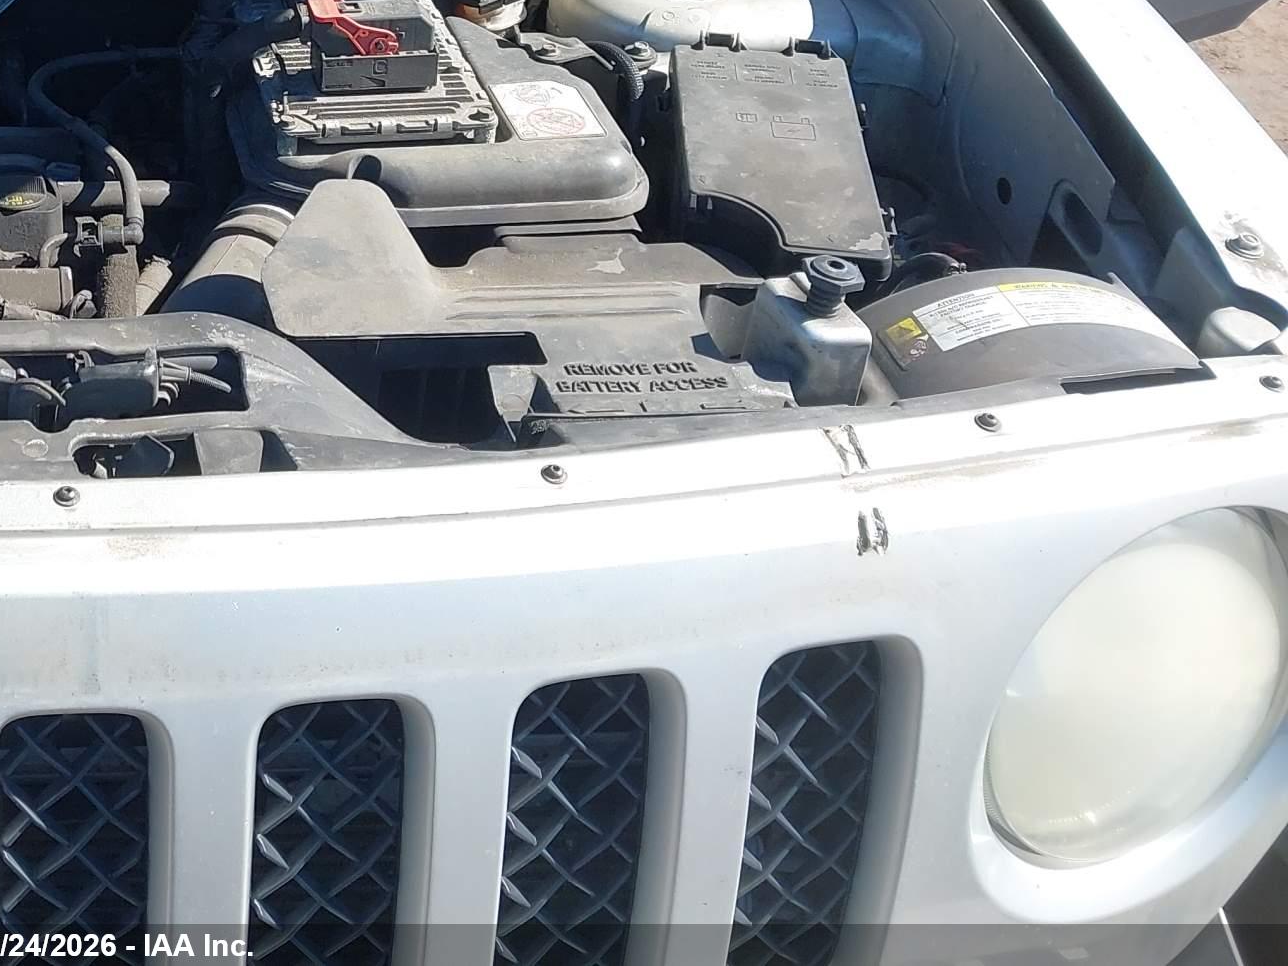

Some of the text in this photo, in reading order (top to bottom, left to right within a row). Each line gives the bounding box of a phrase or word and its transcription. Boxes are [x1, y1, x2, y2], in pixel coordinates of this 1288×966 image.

[937, 293, 975, 308] ATTENTION
[562, 361, 698, 376] REMOVE FOR
[556, 377, 729, 393] BATTERY ACCESS
